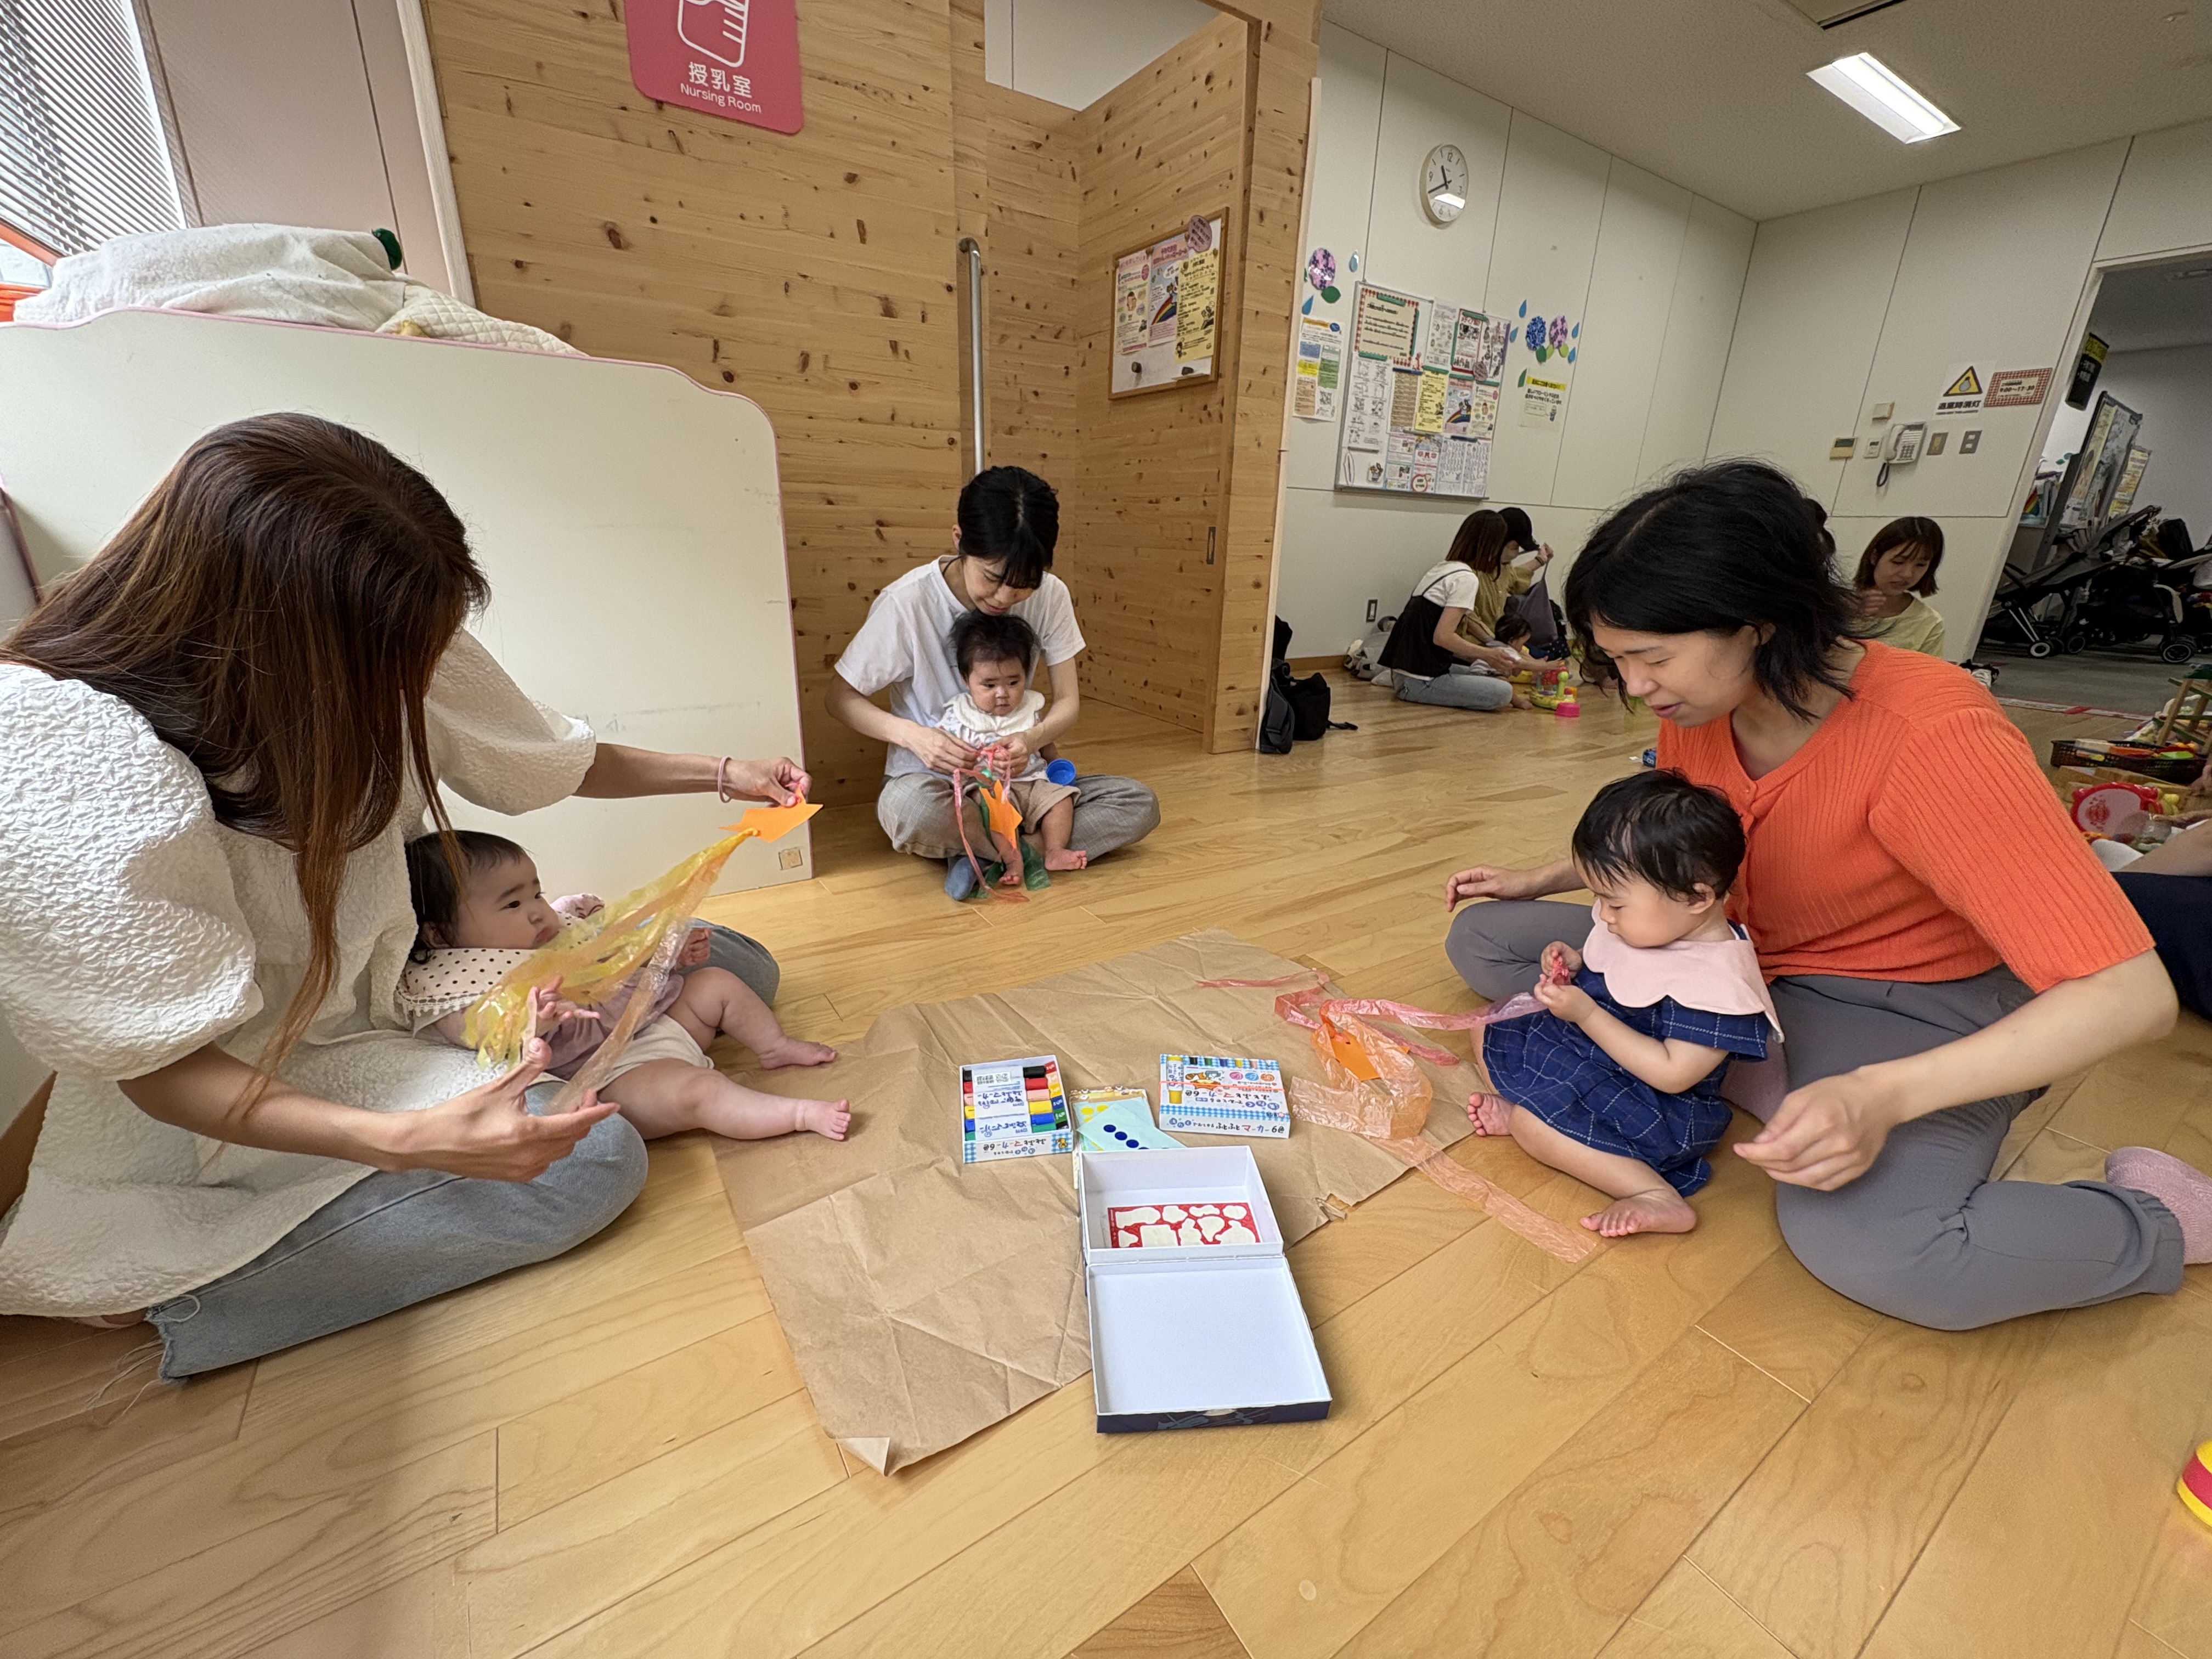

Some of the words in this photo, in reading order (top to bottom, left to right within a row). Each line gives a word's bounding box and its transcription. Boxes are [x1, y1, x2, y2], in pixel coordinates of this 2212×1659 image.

[689, 61, 752, 98] 授乳室
[680, 83, 726, 106] Nursing
[728, 96, 761, 113] Room
